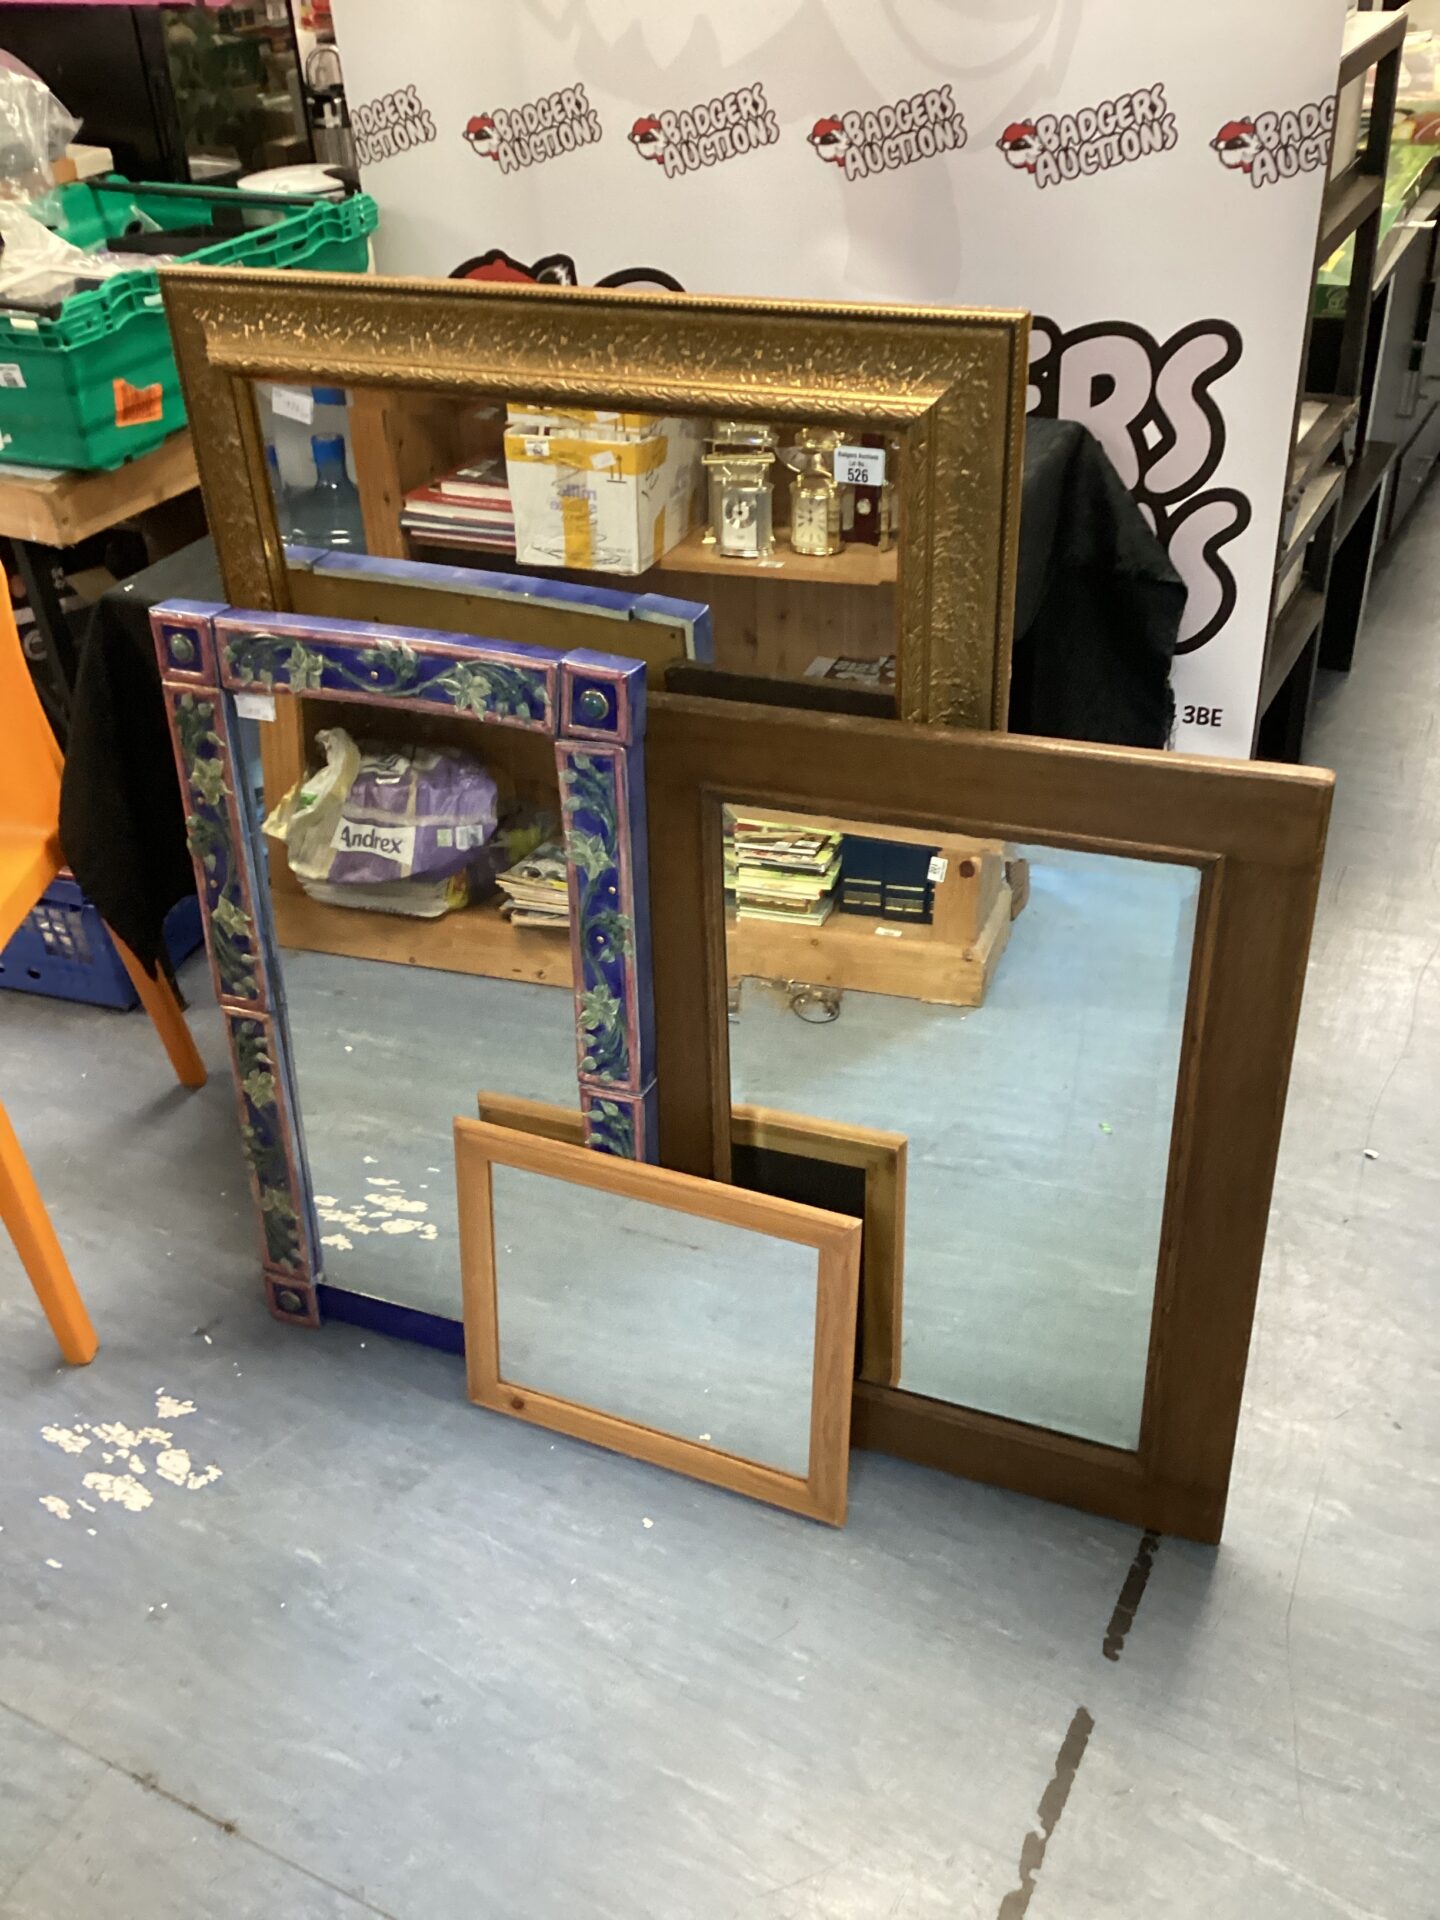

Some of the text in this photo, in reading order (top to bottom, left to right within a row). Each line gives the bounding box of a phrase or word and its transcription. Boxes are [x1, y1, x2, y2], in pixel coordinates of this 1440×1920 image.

[356, 109, 437, 167] UCTIONS
[491, 82, 590, 143] BADGERS
[498, 109, 602, 175] AUCTIONS
[659, 82, 767, 145] BADGERS
[842, 84, 956, 148] BADGERS
[1035, 82, 1167, 153] BADGERS
[662, 110, 780, 179] AUCTIONS
[845, 113, 968, 182] AUCTIONS
[1035, 113, 1178, 189] AUCTIONS
[847, 467, 869, 483] 526
[1182, 704, 1224, 727] 3BE
[341, 825, 403, 855] Andrex
